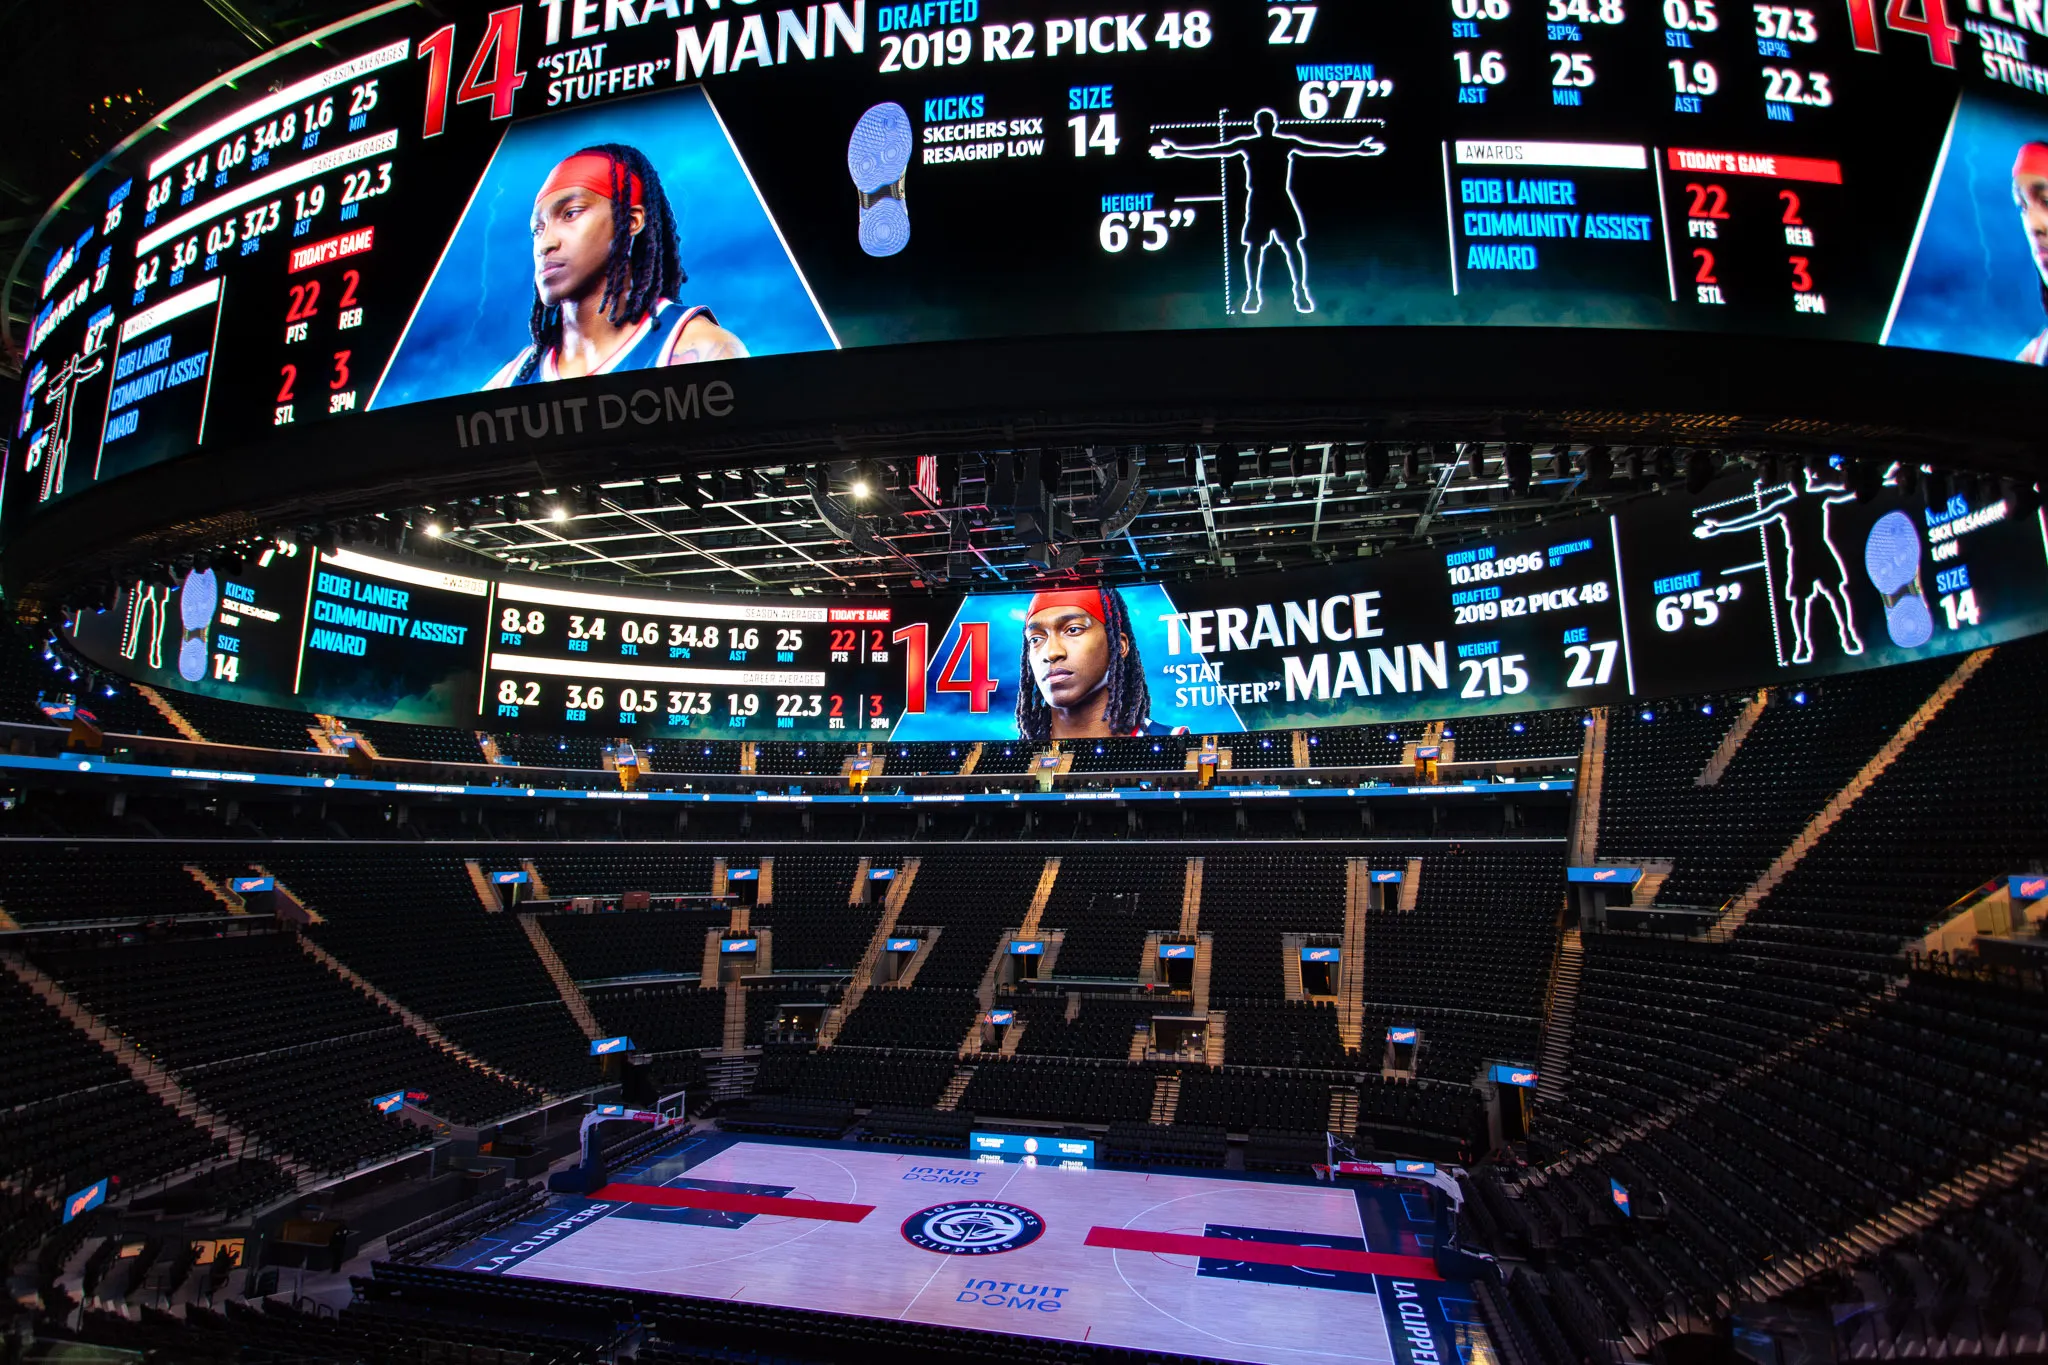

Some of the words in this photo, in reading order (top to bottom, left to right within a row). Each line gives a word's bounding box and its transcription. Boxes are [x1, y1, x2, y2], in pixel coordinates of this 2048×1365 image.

[878, 0, 977, 32] DRAFTED
[1268, 7, 1317, 43] 27
[1754, 5, 1816, 42] 37.3
[675, 0, 865, 81] MANN
[879, 28, 971, 72] 2019
[982, 22, 1034, 61] R2
[1045, 14, 1147, 56] PICK
[1155, 11, 1211, 48] 48
[418, 6, 526, 138] 14
[1296, 64, 1374, 82] WINGSPAN
[1454, 52, 1505, 84] 1.6
[1551, 53, 1594, 86] 25
[1669, 60, 1717, 94] 1.9
[350, 80, 377, 115] 25
[1069, 84, 1113, 110] SIZE
[1763, 68, 1831, 106] 22.3
[305, 98, 332, 133] 1.6
[925, 94, 984, 122] KICKS
[252, 114, 295, 155] 34.8
[923, 121, 1007, 145] SKECHERS
[1010, 118, 1042, 135] SKX
[1068, 114, 1120, 156] 14
[218, 136, 245, 171] 0.6
[923, 142, 1004, 164] RESAGRIP
[1008, 140, 1044, 156] LOW
[1465, 145, 1523, 161] AWARDS
[1738, 155, 1776, 175] GAME
[341, 163, 391, 205] 22.3
[1461, 178, 1505, 203] BOB
[1506, 179, 1576, 205] LANIER
[296, 186, 324, 220] 1.9
[1102, 192, 1154, 213] HEIGHT
[1686, 184, 1729, 219] 22
[1780, 190, 1802, 225] 2
[207, 219, 235, 254] 0.5
[1464, 210, 1581, 238] COMMUNITY
[1585, 213, 1652, 240] ASSIST
[1689, 220, 1717, 238] PTS
[172, 236, 197, 271] 3.6
[340, 230, 372, 255] GAME
[1467, 243, 1538, 270] AWARD
[1693, 248, 1716, 283] 2
[135, 256, 158, 290] 8.2
[1789, 257, 1812, 291] 3
[286, 280, 320, 322] 22
[340, 270, 359, 308] 2
[1698, 286, 1725, 303] STL
[339, 308, 362, 329] REB
[286, 323, 307, 344] PTS
[116, 352, 135, 380] BOB
[136, 335, 172, 371] LANIER
[330, 350, 351, 389] 3
[111, 368, 168, 411] COMMUNITY
[166, 351, 209, 388] ASSIST
[277, 364, 296, 402] 2
[275, 405, 293, 425] STL
[330, 391, 355, 413] 3PM
[105, 409, 139, 443] AWARD
[1446, 550, 1477, 566] BORN
[1478, 548, 1494, 562] ON
[1548, 539, 1590, 557] BROOKLYN
[1448, 552, 1543, 585] 10.18.1996
[1936, 565, 1969, 594] SIZE
[225, 582, 254, 603] KICKS
[317, 572, 351, 598] BOB
[354, 578, 409, 612] LANIER
[1452, 587, 1498, 605] DRAFTED
[1654, 572, 1701, 594] HEIGHT
[745, 608, 779, 620] SEASON
[781, 609, 823, 621] AVERAGES
[866, 610, 889, 620] GAME
[1455, 602, 1498, 624] 2019
[1500, 597, 1527, 617] R2
[1528, 587, 1578, 613] PICK
[1579, 582, 1608, 603] 48
[1940, 588, 1979, 630] 14
[314, 599, 409, 637] COMMUNITY
[410, 620, 468, 645] ASSIST
[502, 608, 544, 634] 8.8
[568, 616, 606, 640] 3.4
[622, 621, 659, 644] 0.6
[1159, 590, 1384, 656] TERANCE
[217, 634, 240, 652] SIZE
[309, 628, 366, 656] AWARD
[501, 632, 521, 645] PTS
[568, 640, 588, 651] REB
[669, 624, 719, 648] 34.8
[729, 628, 759, 649] 1.6
[776, 629, 802, 650] 25
[830, 630, 855, 650] 22
[871, 630, 884, 650] 2
[1458, 640, 1500, 657] WEIGHT
[1564, 629, 1587, 645] AGE
[621, 644, 638, 655] STL
[729, 650, 747, 661] AST
[777, 652, 793, 662] MIN
[832, 652, 848, 662] PTS
[872, 652, 888, 662] REB
[215, 654, 238, 682] 14
[895, 623, 997, 712] 14
[1282, 641, 1447, 701] MANN
[1459, 654, 1528, 698] 215
[1565, 641, 1617, 687] 27
[499, 680, 540, 705] 8.2
[743, 673, 775, 684] CAREER
[777, 674, 821, 686] AVERAGES
[566, 685, 604, 709] 3.6
[620, 689, 657, 712] 0.5
[667, 691, 711, 714] 37.3
[728, 694, 759, 715] 1.9
[776, 695, 822, 716] 22.3
[830, 695, 842, 716] 2
[870, 695, 882, 716] 3
[830, 718, 845, 728] STL
[871, 718, 889, 728] 3PM
[924, 1204, 955, 1217] LOS
[970, 1202, 1038, 1227] ANGELES
[474, 1255, 516, 1273] LA
[510, 1203, 610, 1254] CLIPPERS
[911, 1233, 1013, 1254] CLIPPERS
[1392, 1281, 1419, 1299] LA
